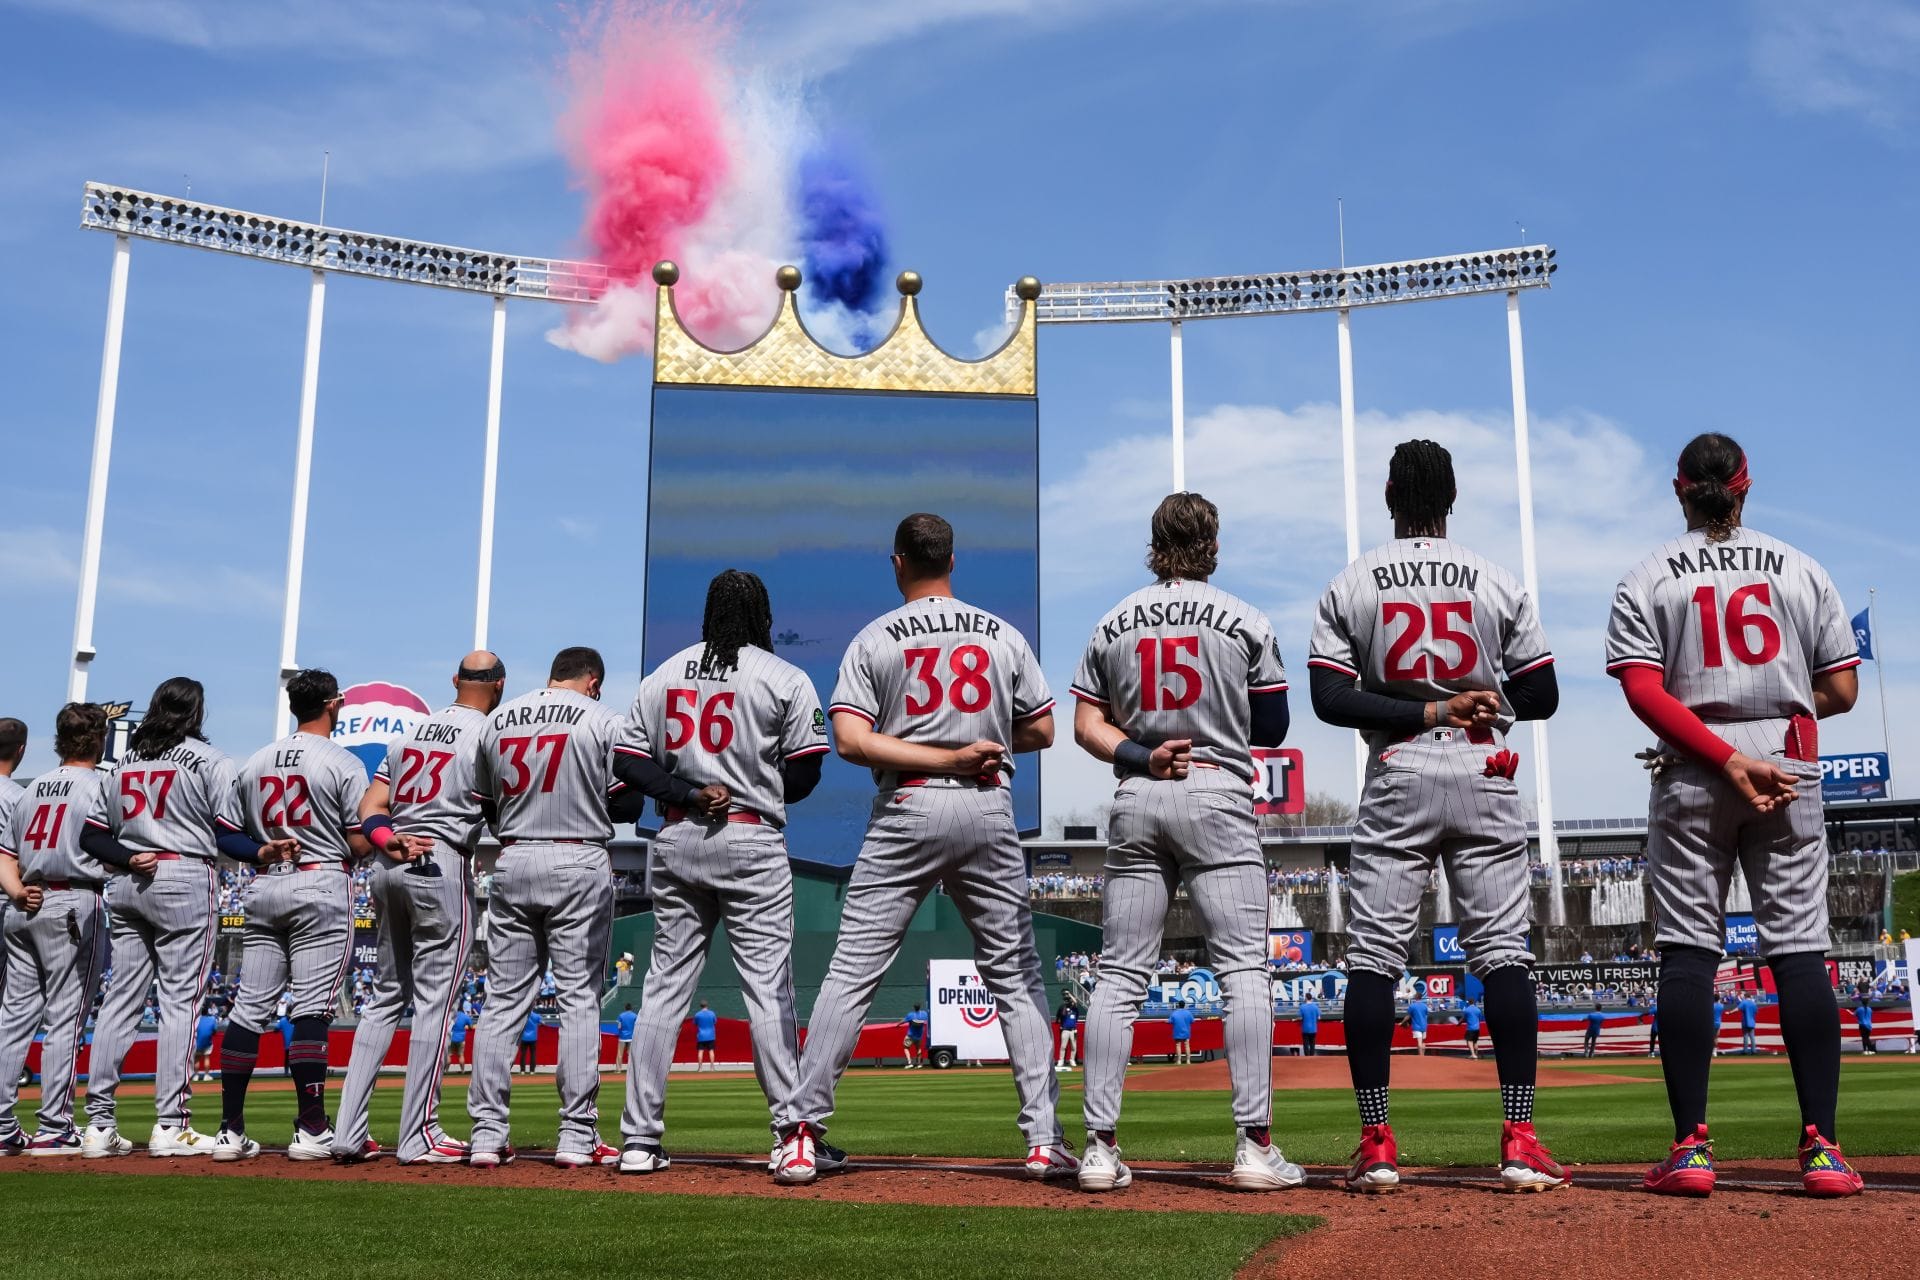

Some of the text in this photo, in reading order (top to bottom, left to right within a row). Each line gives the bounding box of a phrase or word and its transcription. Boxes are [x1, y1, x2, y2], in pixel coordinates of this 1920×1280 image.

[1372, 561, 1478, 591] BUXTON
[1667, 547, 1784, 579] MARTIN
[885, 613, 1000, 641] WALLNER
[1103, 601, 1242, 644] KEASCHALL
[1383, 601, 1478, 679] 25
[1691, 583, 1781, 669] 16
[903, 645, 992, 716] 38
[1135, 636, 1203, 711] 15
[333, 716, 414, 737] RE/MA
[415, 724, 461, 744] LEWIS
[494, 705, 585, 731] CARATINI
[666, 688, 735, 754] 56
[275, 750, 303, 768] LEE
[394, 748, 455, 804] 23
[499, 734, 569, 796] 37
[36, 781, 73, 798] RYAN
[120, 770, 177, 820] 57
[260, 775, 312, 828] 22
[24, 804, 67, 850] 41
[1429, 978, 1450, 994] QT
[1547, 969, 1593, 981] VIEWS
[1604, 967, 1651, 979] FRESH
[1839, 968, 1873, 978] NEXT
